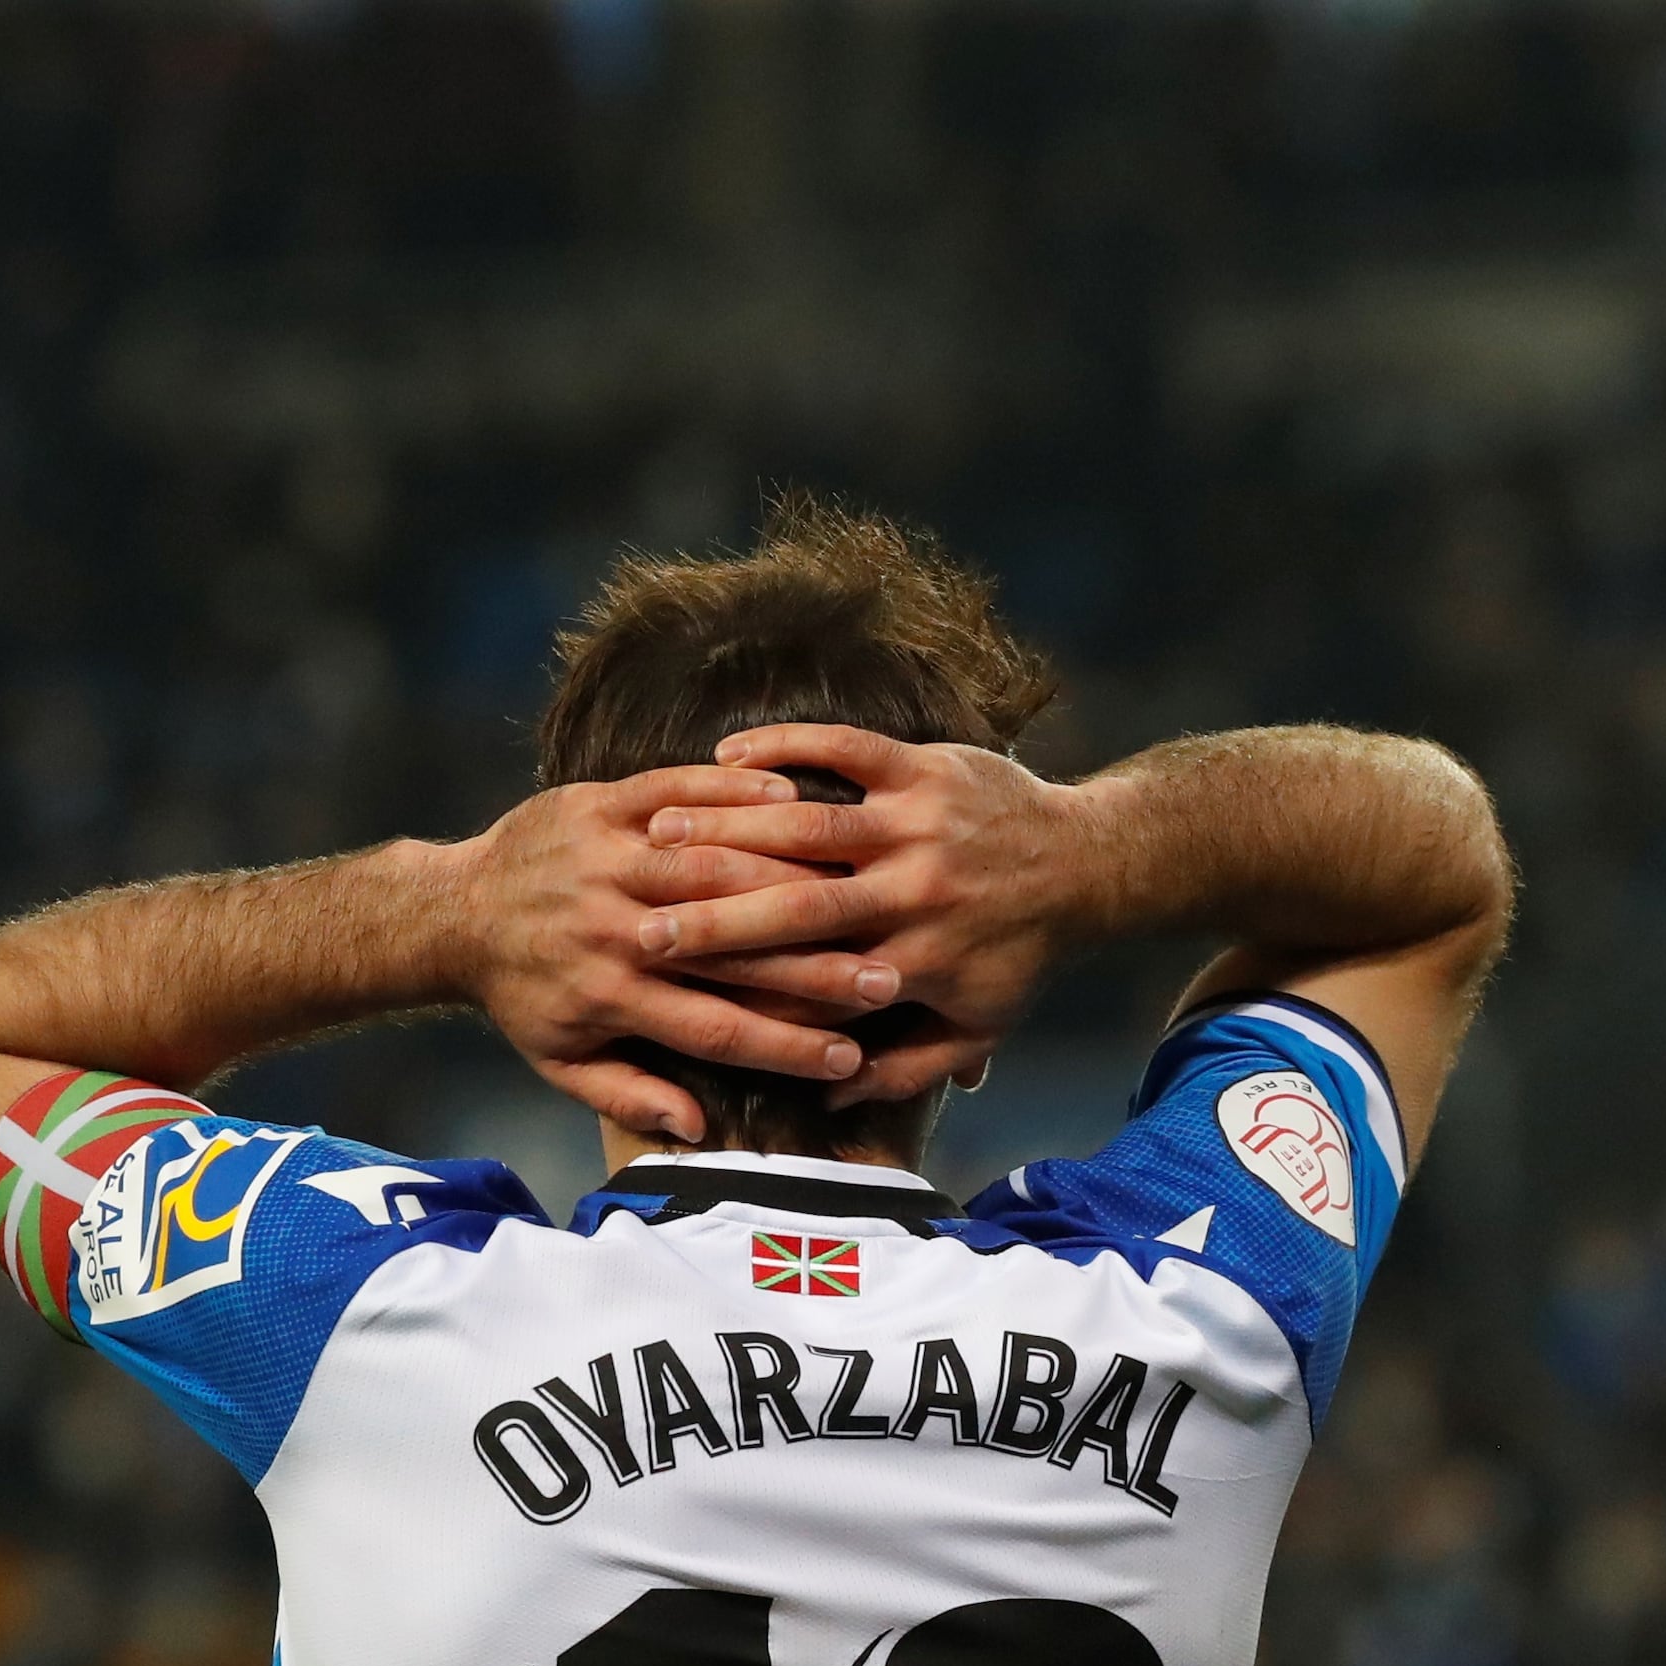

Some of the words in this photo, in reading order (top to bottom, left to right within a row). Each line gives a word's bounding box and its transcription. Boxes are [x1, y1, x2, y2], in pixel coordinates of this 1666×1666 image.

[1244, 1081, 1277, 1099] REY
[1285, 1080, 1312, 1093] EL
[97, 1172, 124, 1299] ALE
[472, 1330, 1196, 1526] OYARZABAL
